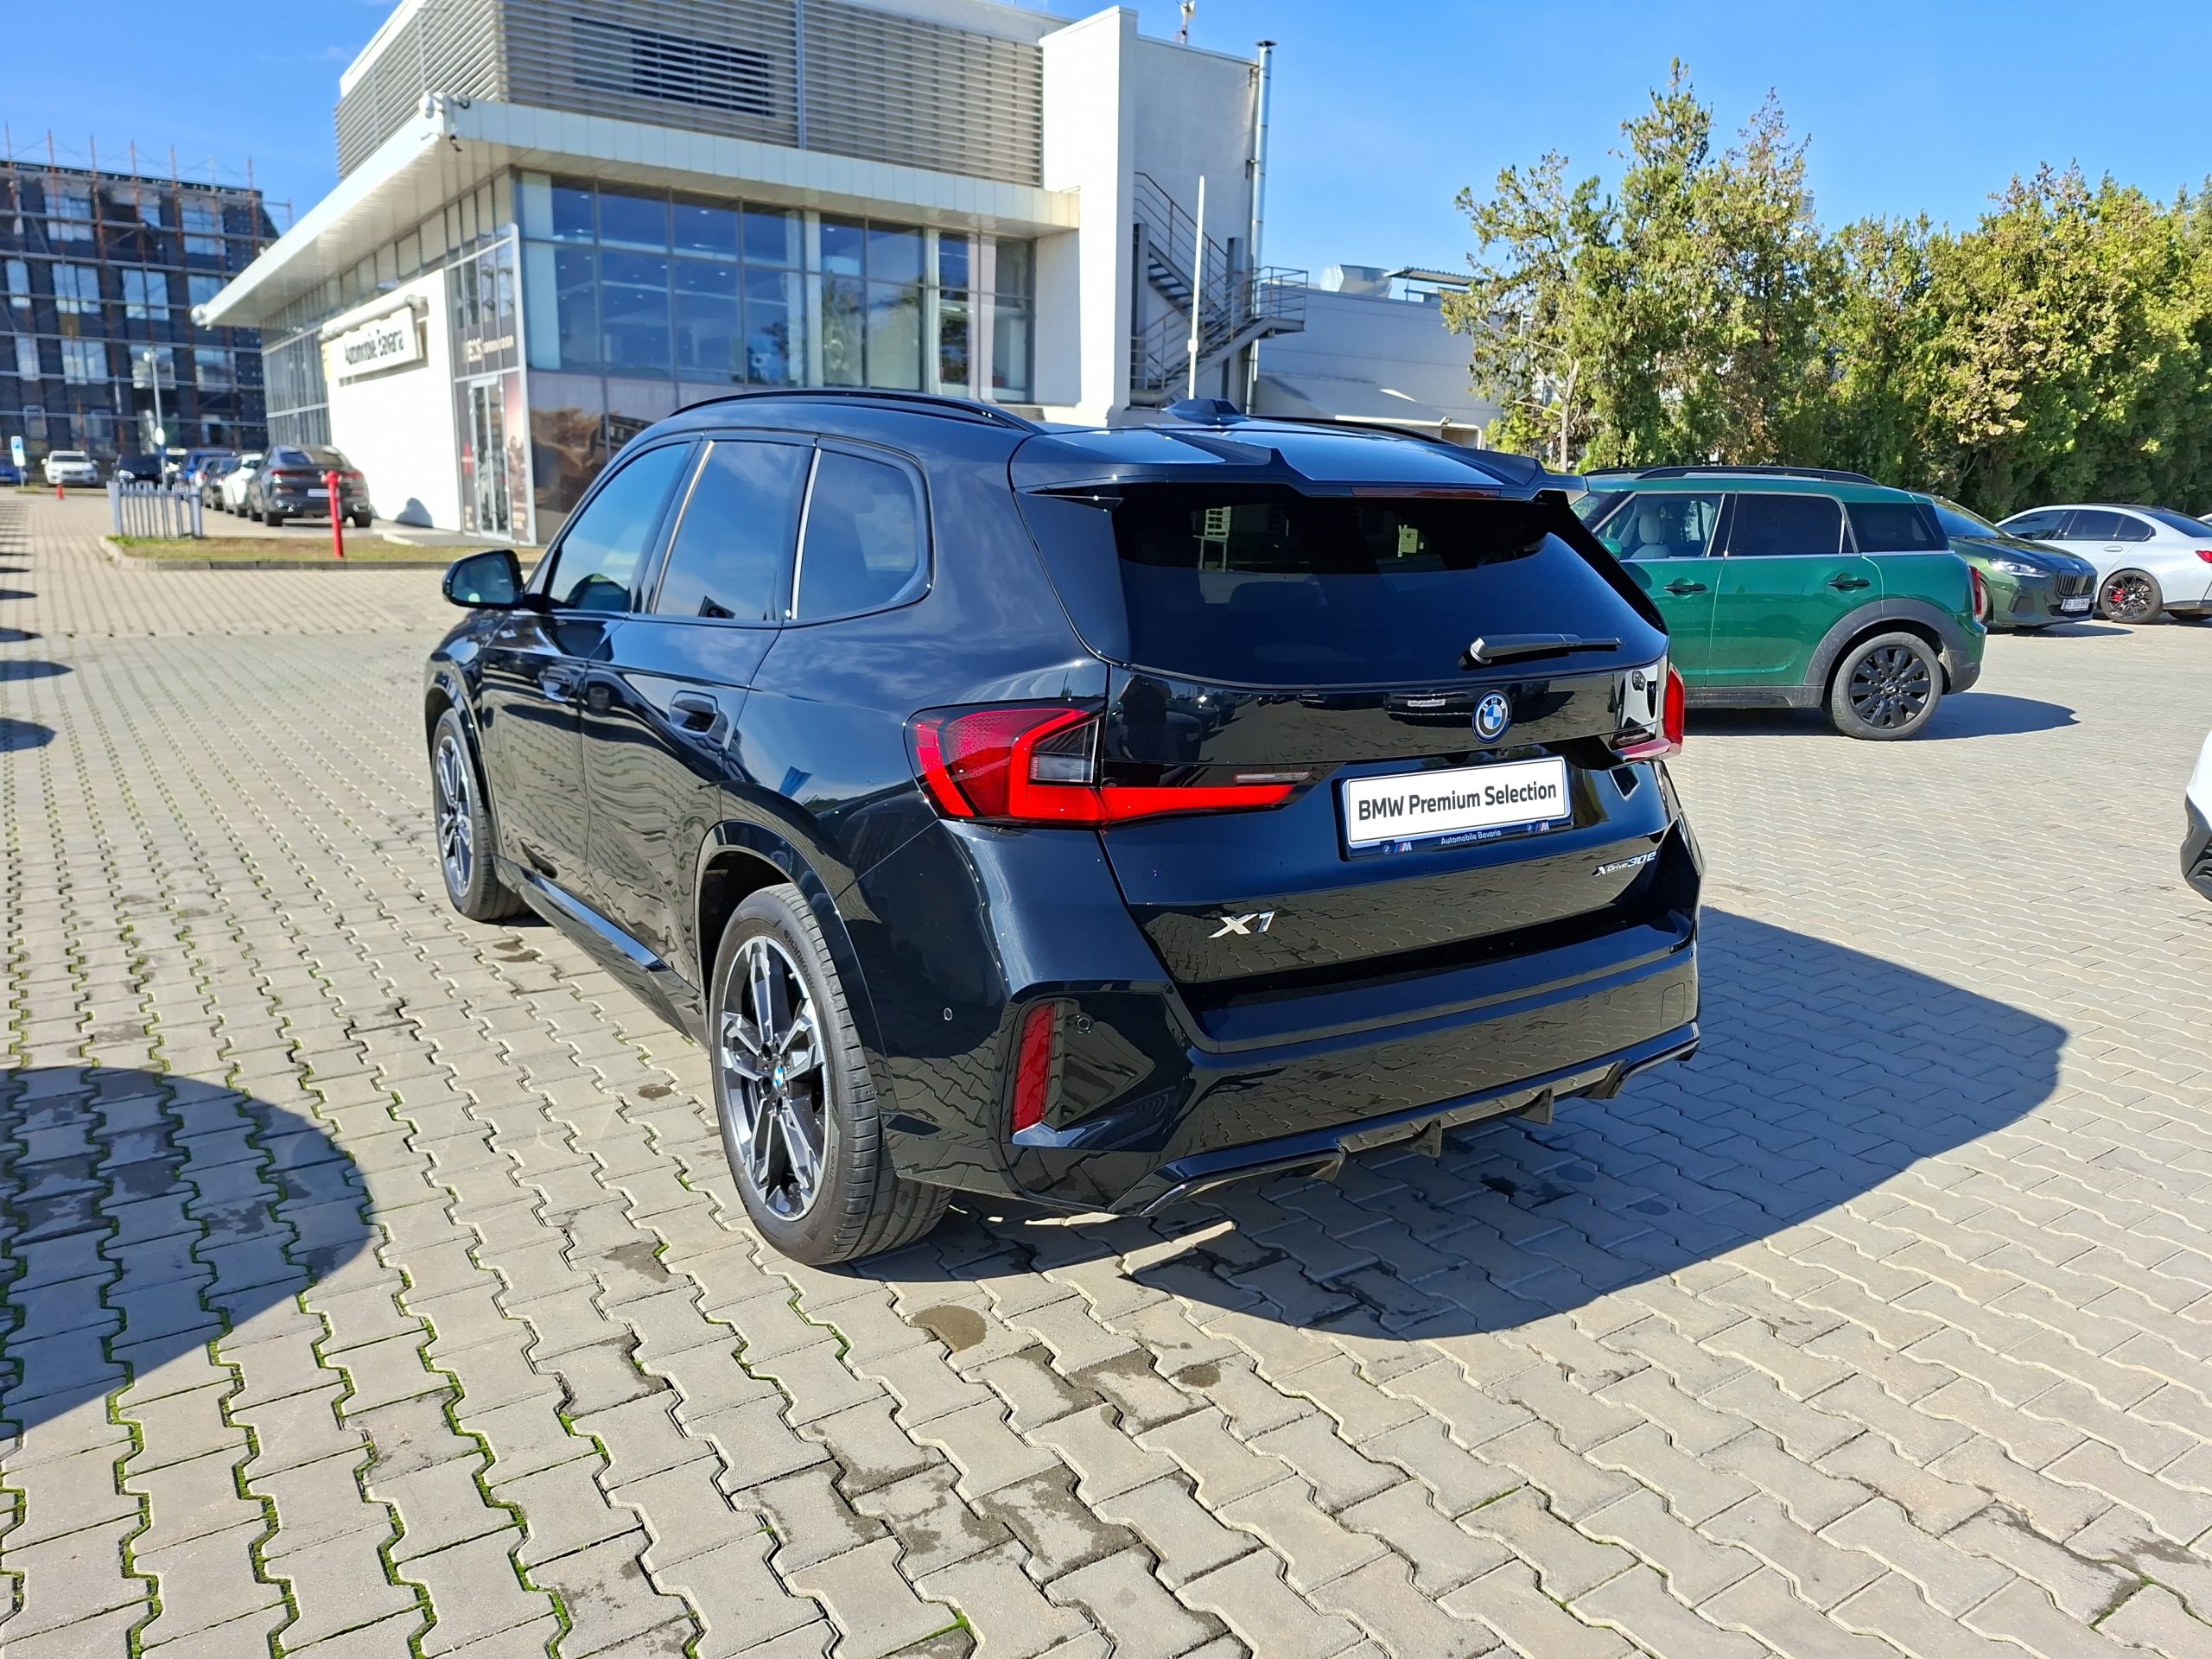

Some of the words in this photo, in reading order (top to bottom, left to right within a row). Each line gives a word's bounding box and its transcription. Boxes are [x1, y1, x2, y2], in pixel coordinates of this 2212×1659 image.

[1358, 796, 1404, 821] BMW
[1408, 790, 1481, 815] Premium
[1484, 781, 1557, 806] Selection
[1440, 833, 1478, 845] Automobile
[1477, 830, 1502, 839] Bavaria
[1208, 911, 1275, 938] X1
